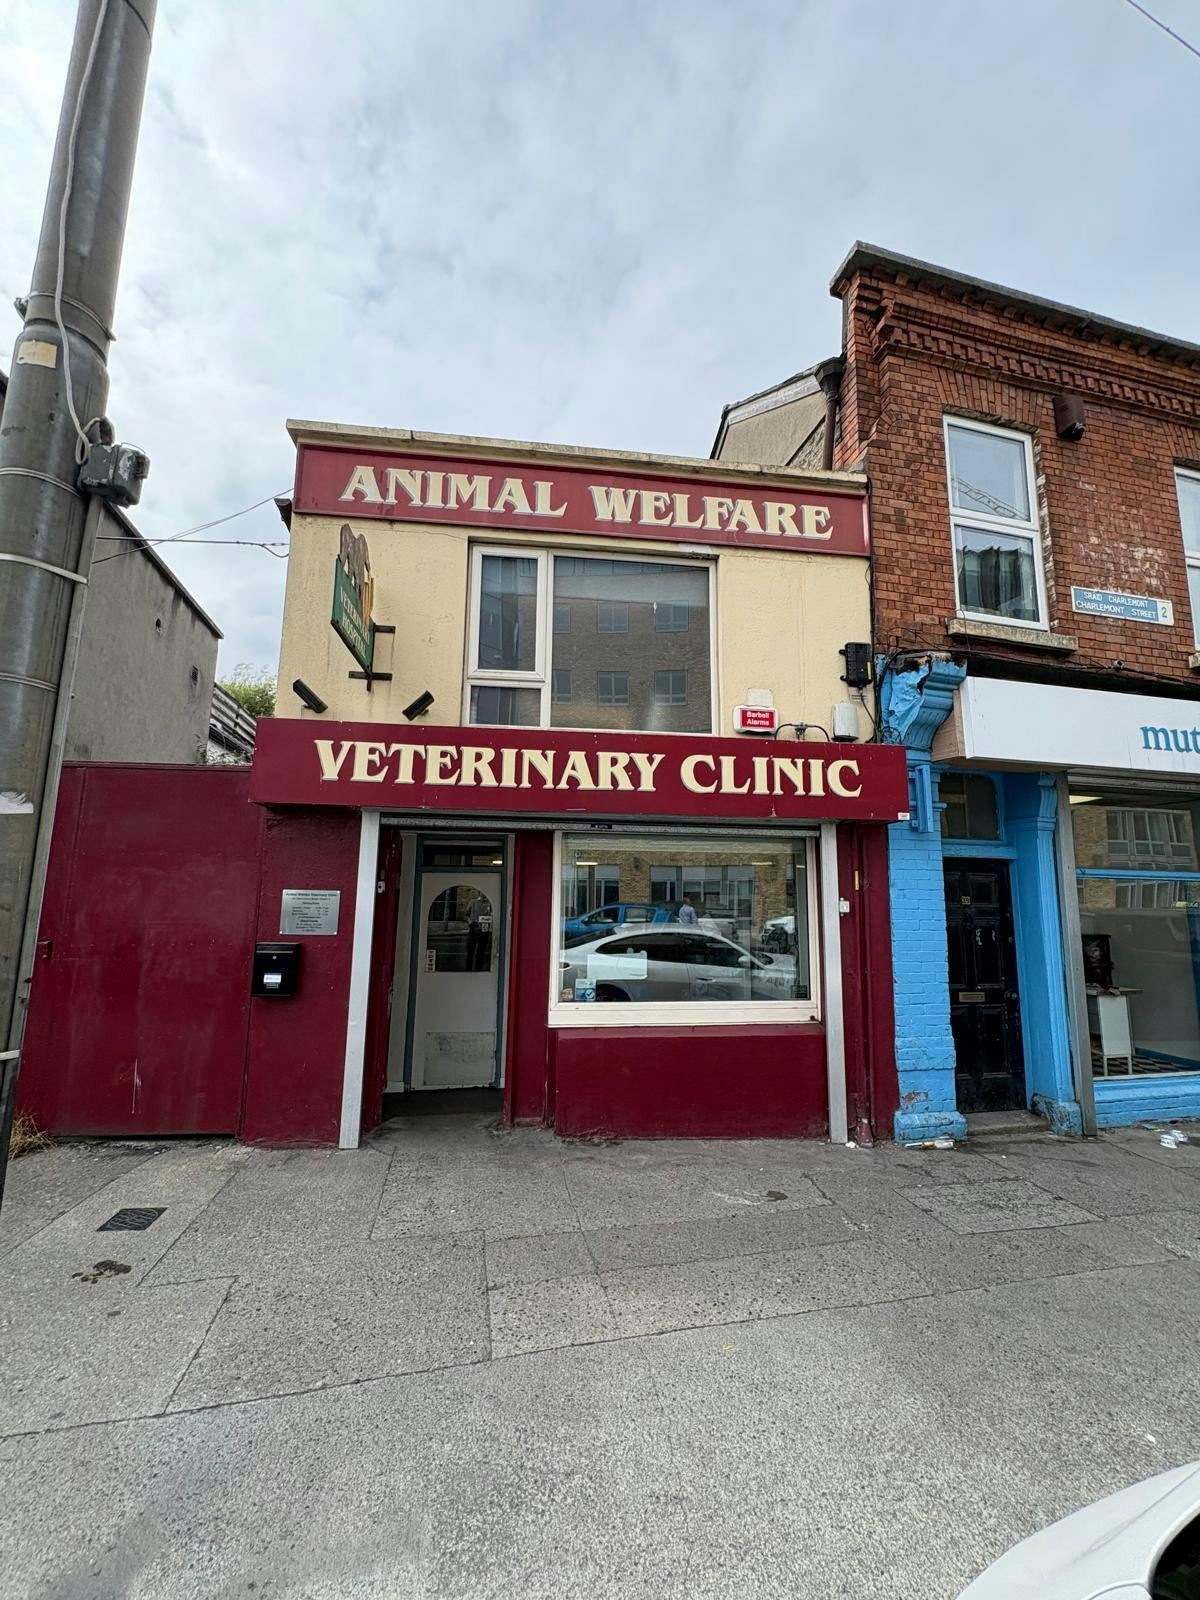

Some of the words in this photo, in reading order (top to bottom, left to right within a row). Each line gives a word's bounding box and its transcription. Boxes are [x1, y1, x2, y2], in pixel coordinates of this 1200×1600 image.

[338, 465, 568, 516] ANIMAL
[588, 485, 834, 540] WELFARE
[1108, 596, 1149, 608] CHARLEMONT
[1076, 600, 1125, 614] CHARLEMONT
[1131, 608, 1157, 619] STREET
[1161, 606, 1168, 618] 2
[746, 711, 770, 719] Barbell
[746, 718, 770, 726] Alarms
[314, 739, 665, 792] VETERINARY
[680, 754, 863, 798] CLINIC
